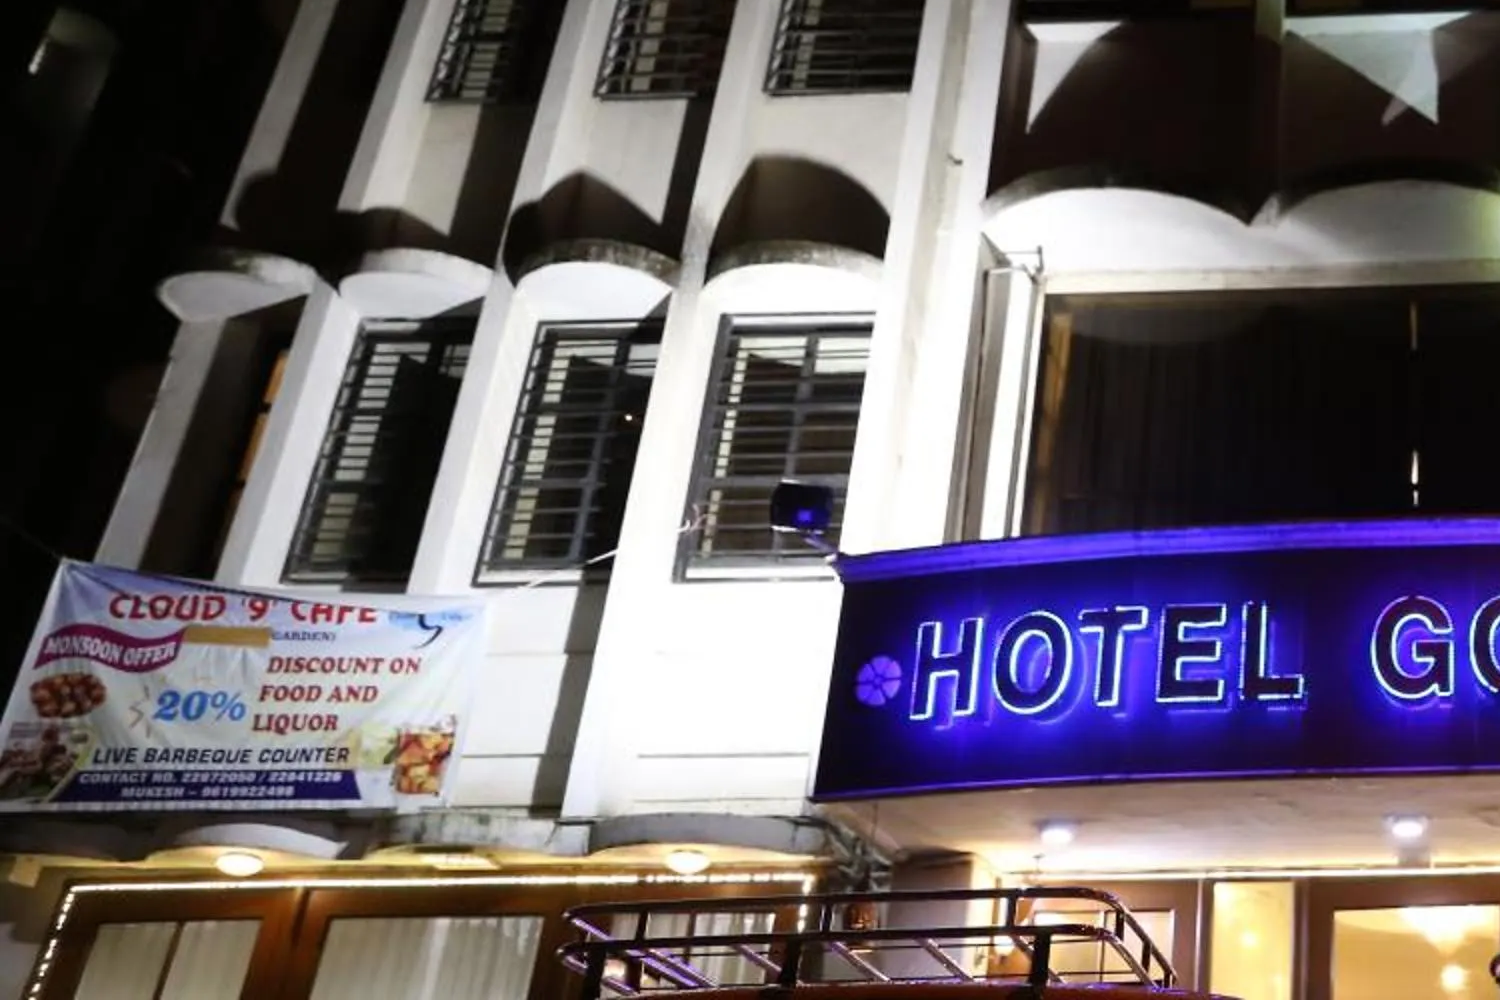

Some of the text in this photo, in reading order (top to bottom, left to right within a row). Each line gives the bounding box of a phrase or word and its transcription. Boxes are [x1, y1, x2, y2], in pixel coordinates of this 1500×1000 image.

[109, 593, 226, 621] CLOUD
[44, 634, 176, 665] MONSOON OFFER
[266, 656, 421, 674] DISCOUNT ON
[908, 600, 1306, 721] HOTEL
[259, 685, 378, 703] FOOD AND
[153, 689, 246, 722] 20%
[252, 714, 339, 735] LIQUOR
[92, 747, 350, 764] LIVE BARBEQUE COUNTER
[79, 772, 147, 784] CONTACT
[121, 786, 185, 798] MUKESH
